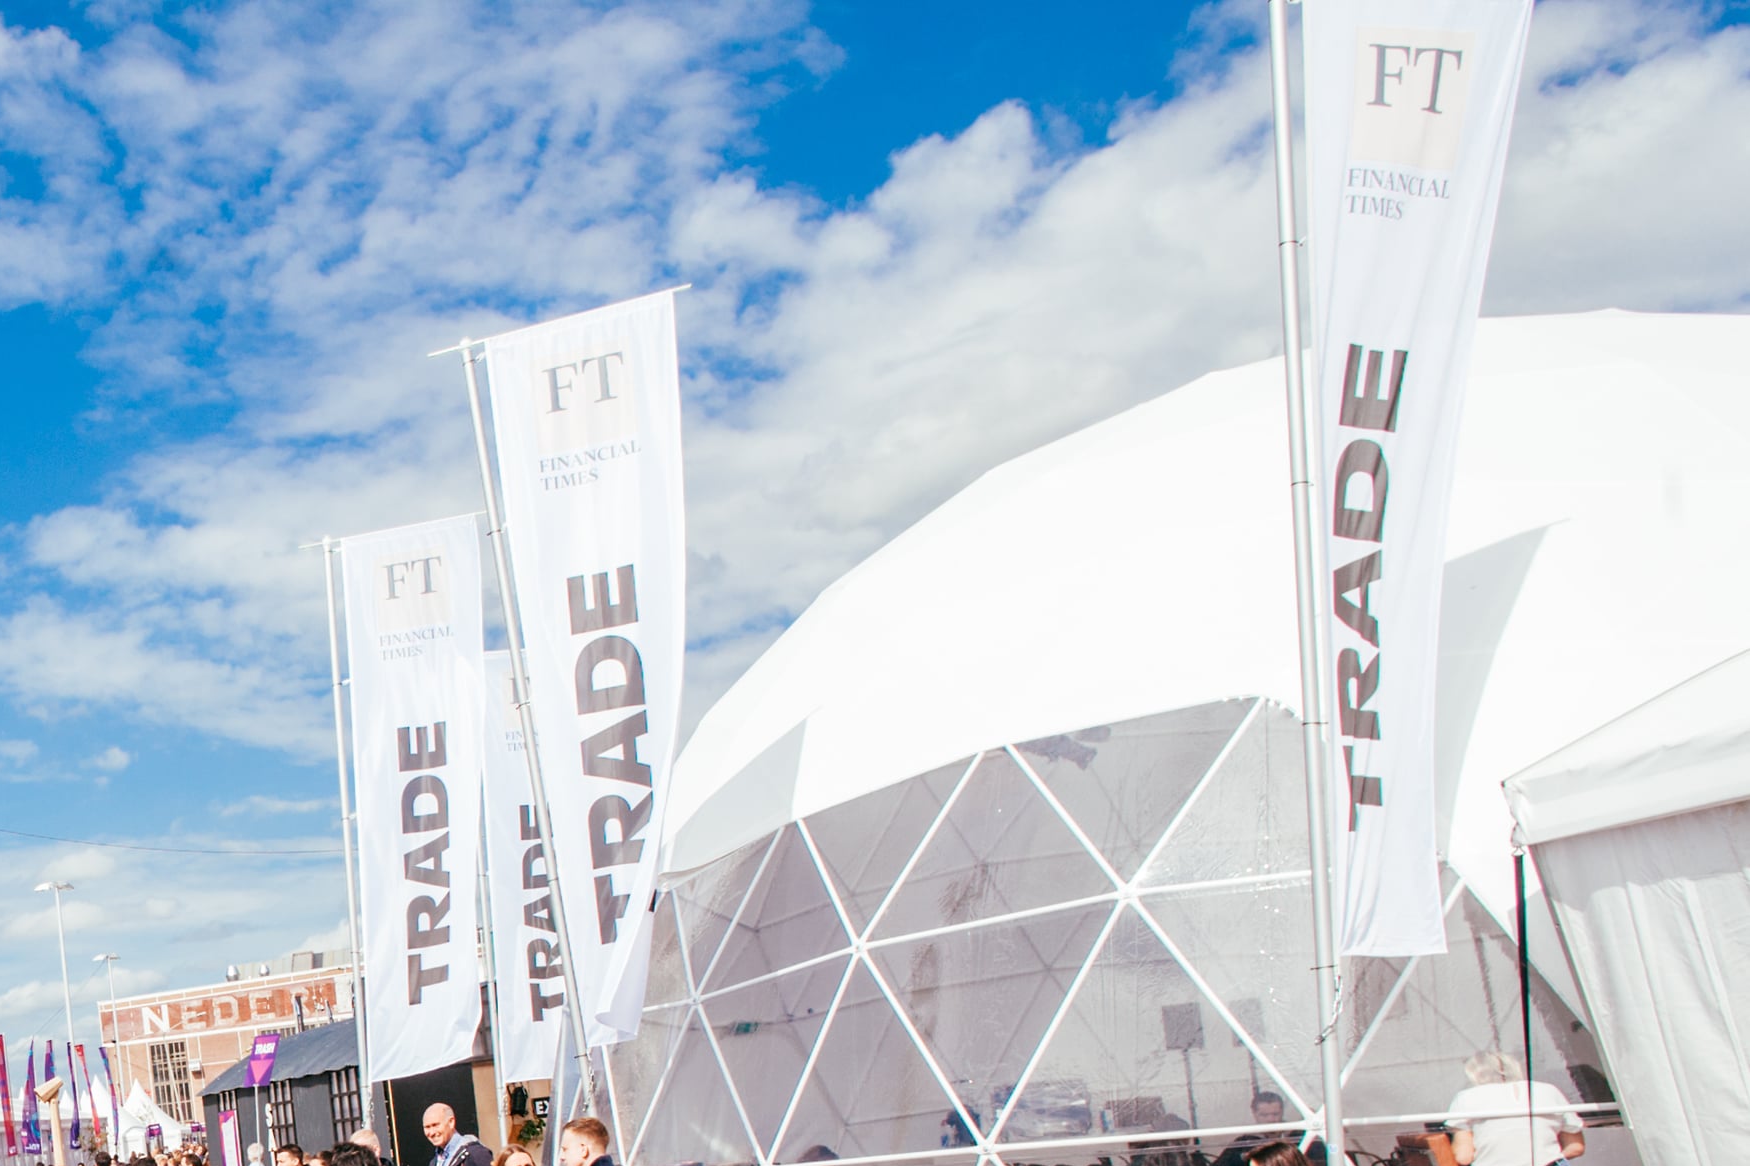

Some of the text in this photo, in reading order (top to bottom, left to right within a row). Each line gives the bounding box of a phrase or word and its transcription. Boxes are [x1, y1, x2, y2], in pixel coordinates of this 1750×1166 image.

[1366, 43, 1463, 115] FT
[1346, 167, 1451, 200] FINANCIAL
[1345, 194, 1402, 221] TIMES
[541, 351, 625, 414] FT
[539, 439, 642, 474] FINANCIAL
[540, 466, 600, 492] TIMES
[381, 555, 443, 601] FT
[1333, 342, 1409, 832] TRADE
[378, 625, 454, 648] FINANCIAL
[380, 646, 424, 662] TIMES
[566, 563, 654, 945] TRADE
[397, 720, 451, 1006] TRADE
